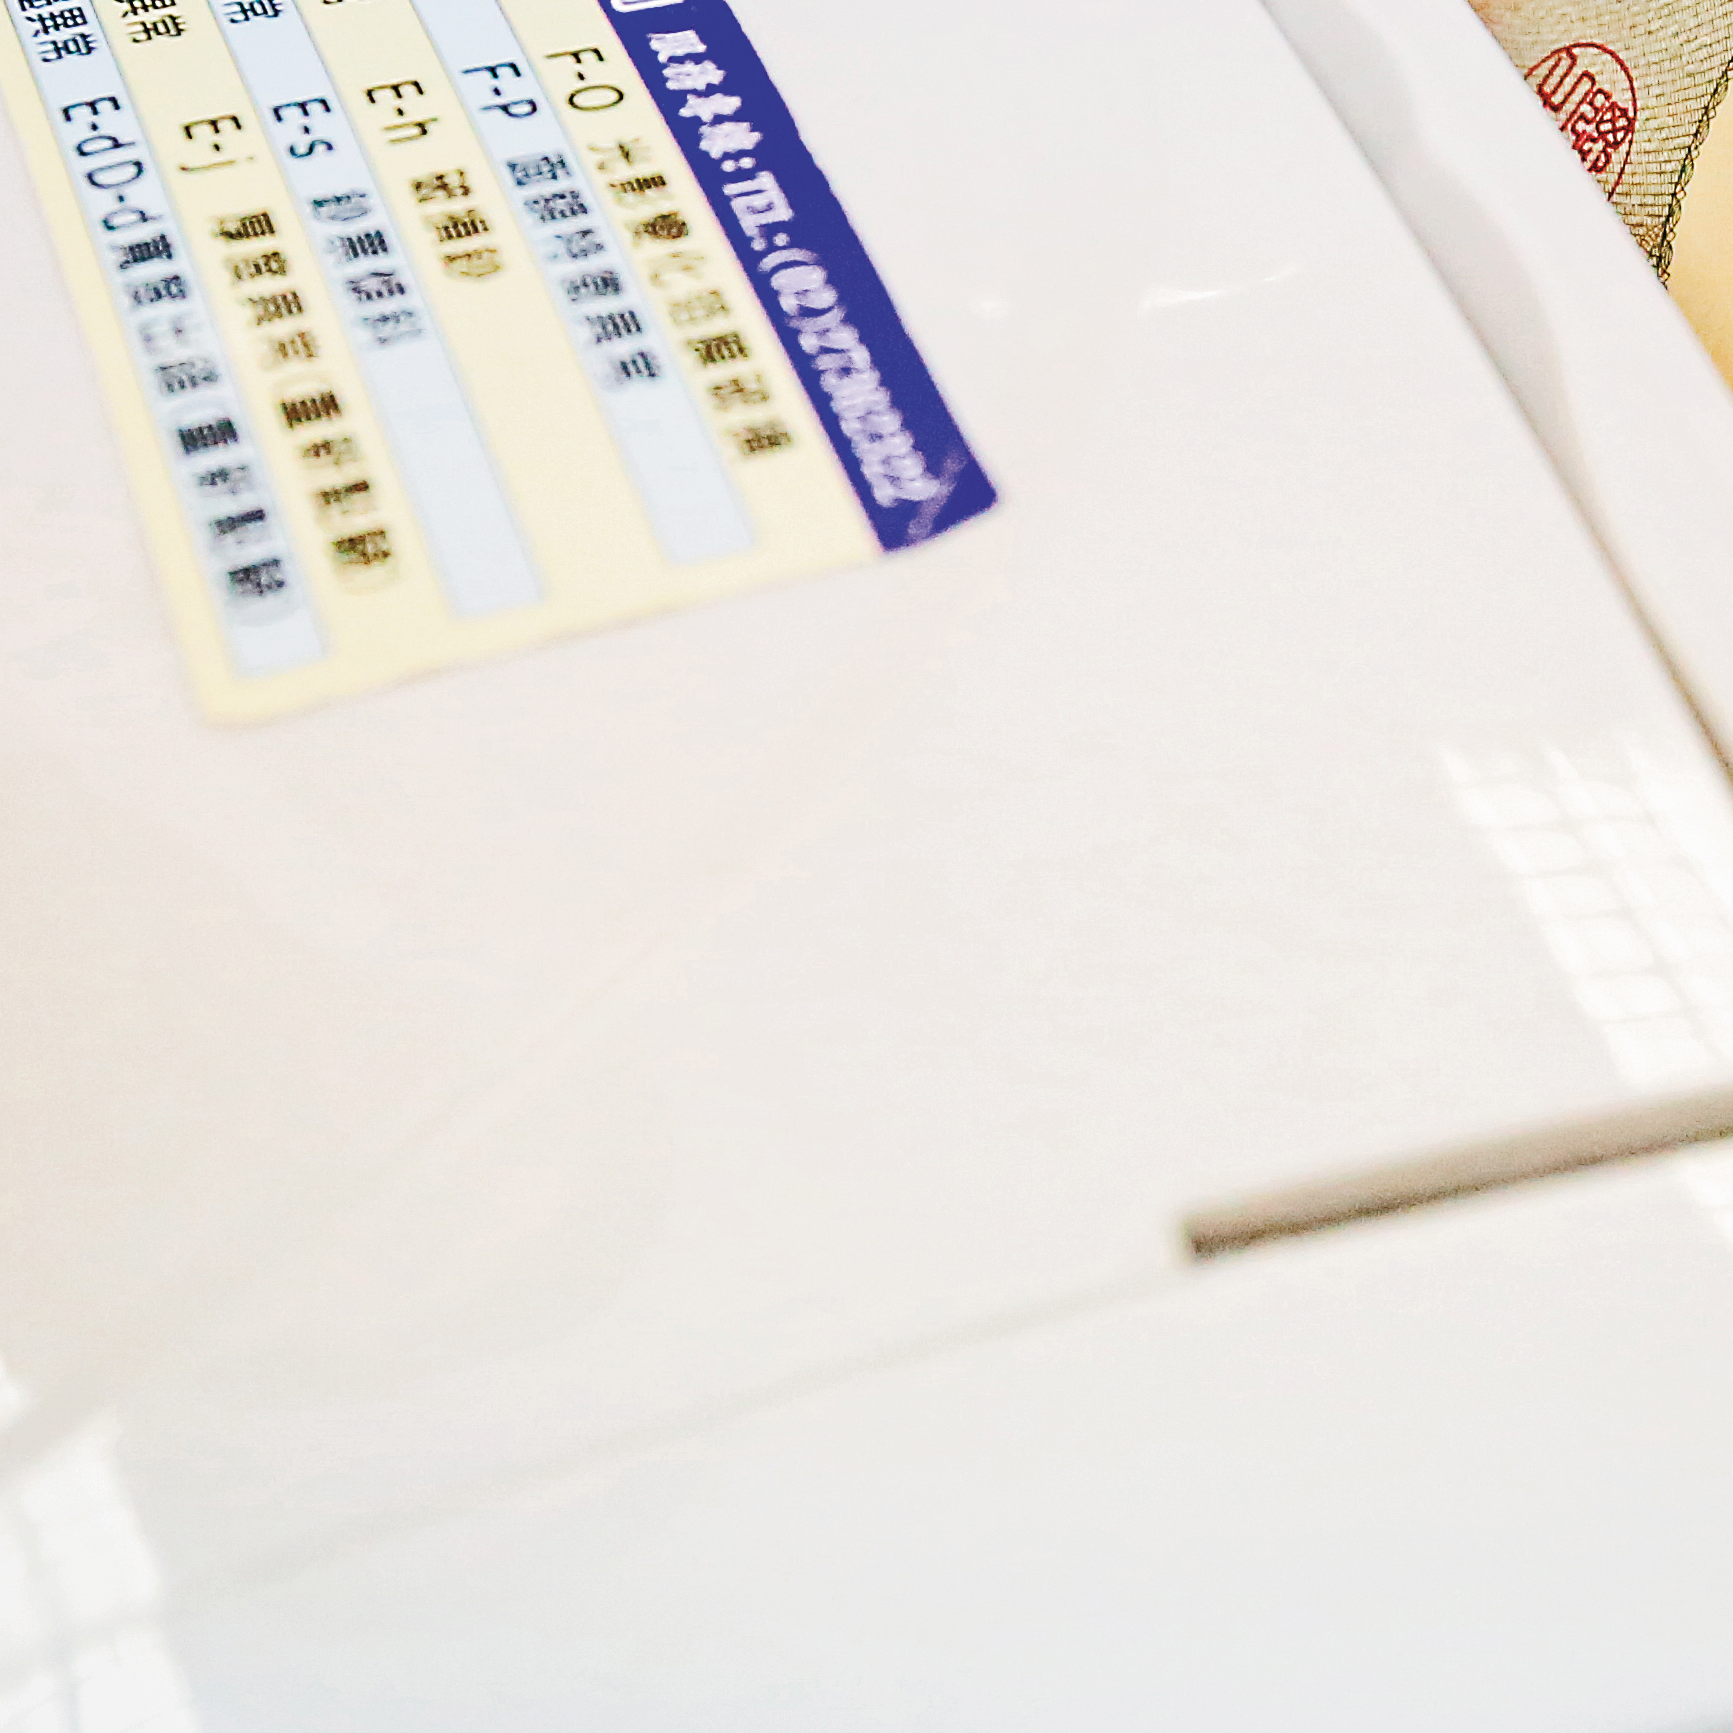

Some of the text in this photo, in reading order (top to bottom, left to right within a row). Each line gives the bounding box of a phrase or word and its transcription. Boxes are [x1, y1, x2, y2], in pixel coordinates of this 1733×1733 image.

[365, 80, 435, 142] E-h
[463, 62, 538, 119] F-P
[180, 114, 255, 174] E-j
[272, 97, 334, 159] E-s
